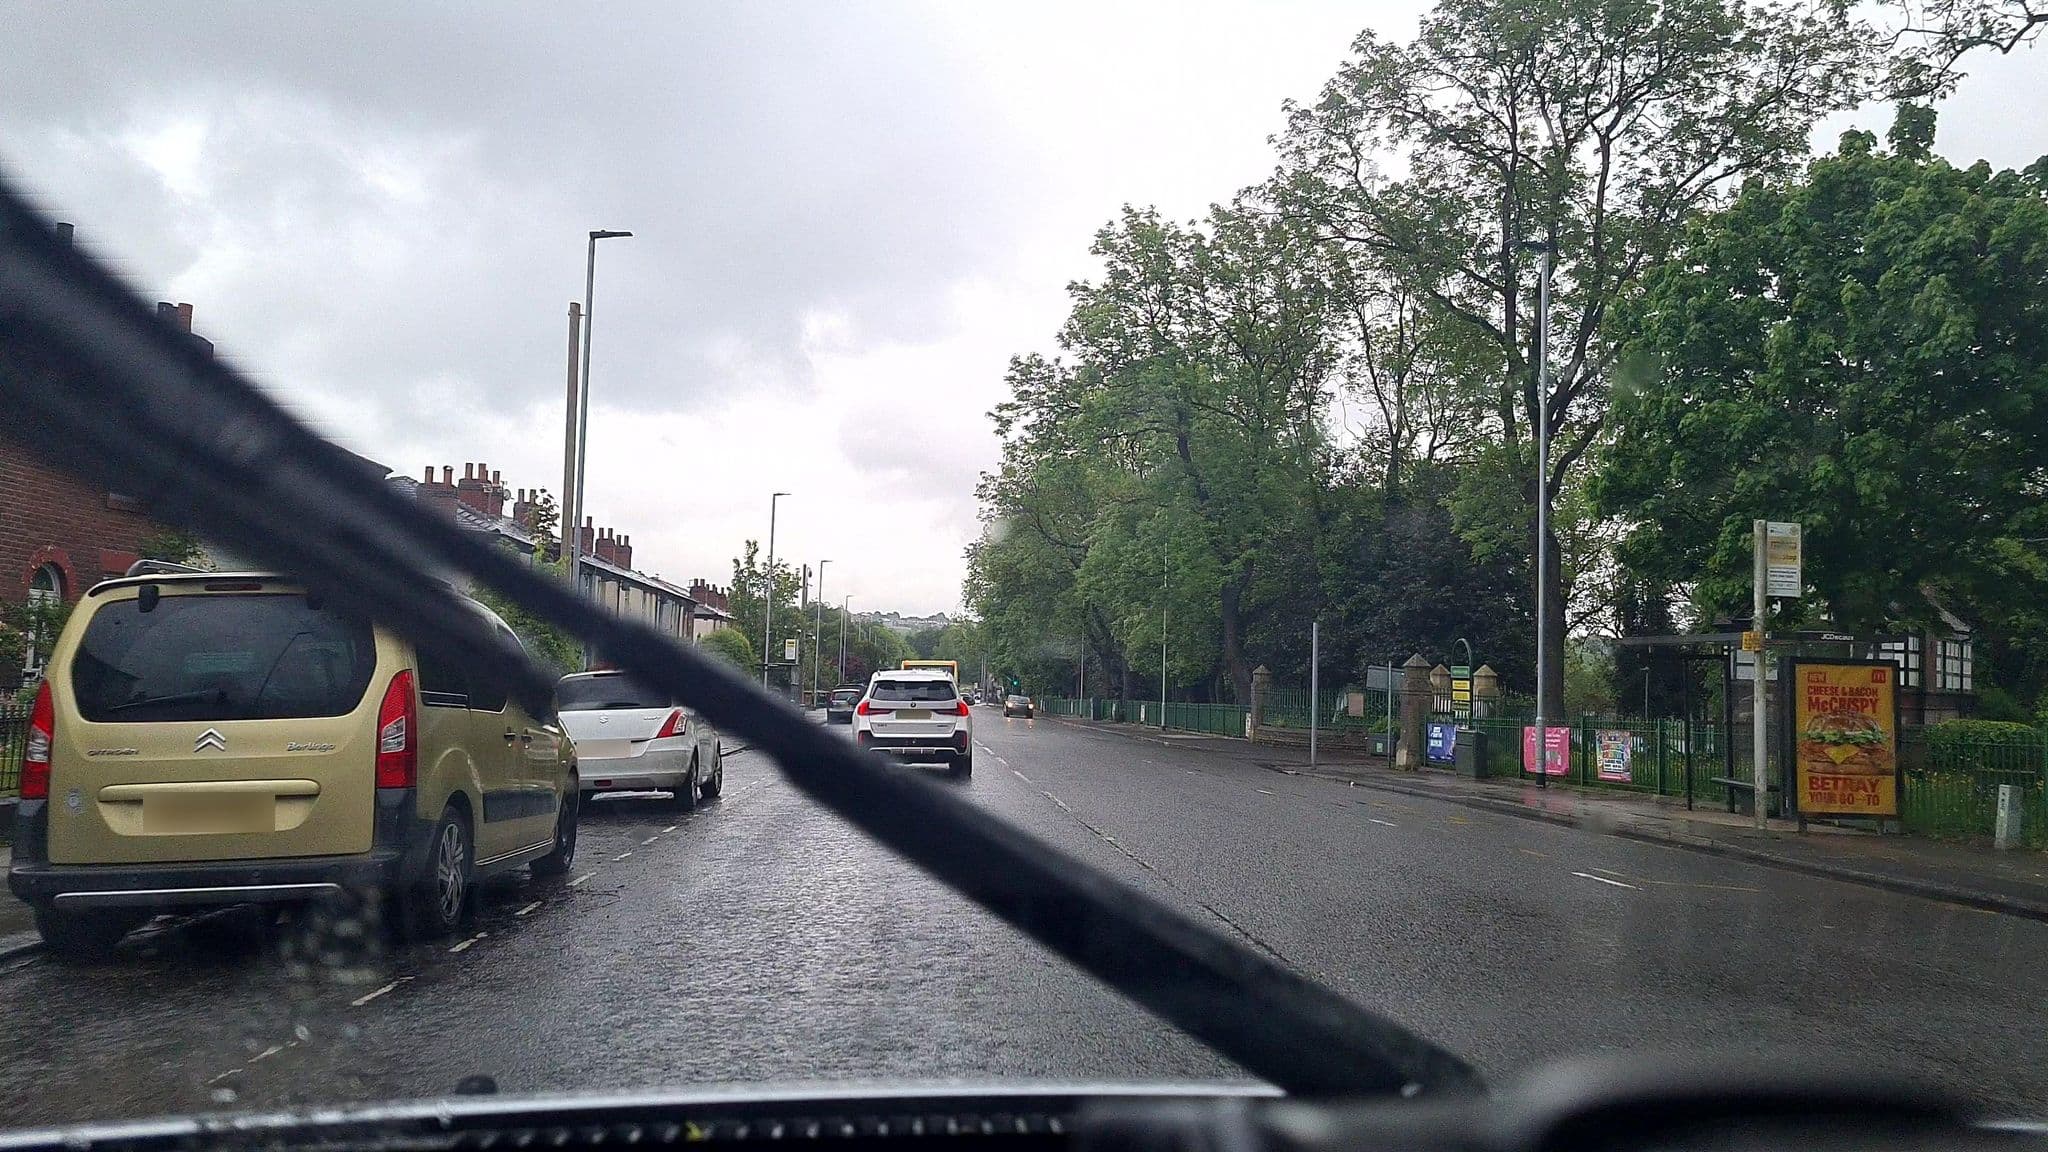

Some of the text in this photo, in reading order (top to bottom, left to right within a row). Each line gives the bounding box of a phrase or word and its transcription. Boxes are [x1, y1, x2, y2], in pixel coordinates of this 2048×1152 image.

[1821, 633, 1854, 641] JCDecaux
[1807, 685, 1839, 696] CHEESE
[1849, 686, 1879, 698] BACON
[1807, 696, 1880, 714] McCRISPY
[287, 741, 336, 753] Berlingo
[1808, 776, 1880, 793] BETRAY
[1809, 791, 1837, 804] YOUR
